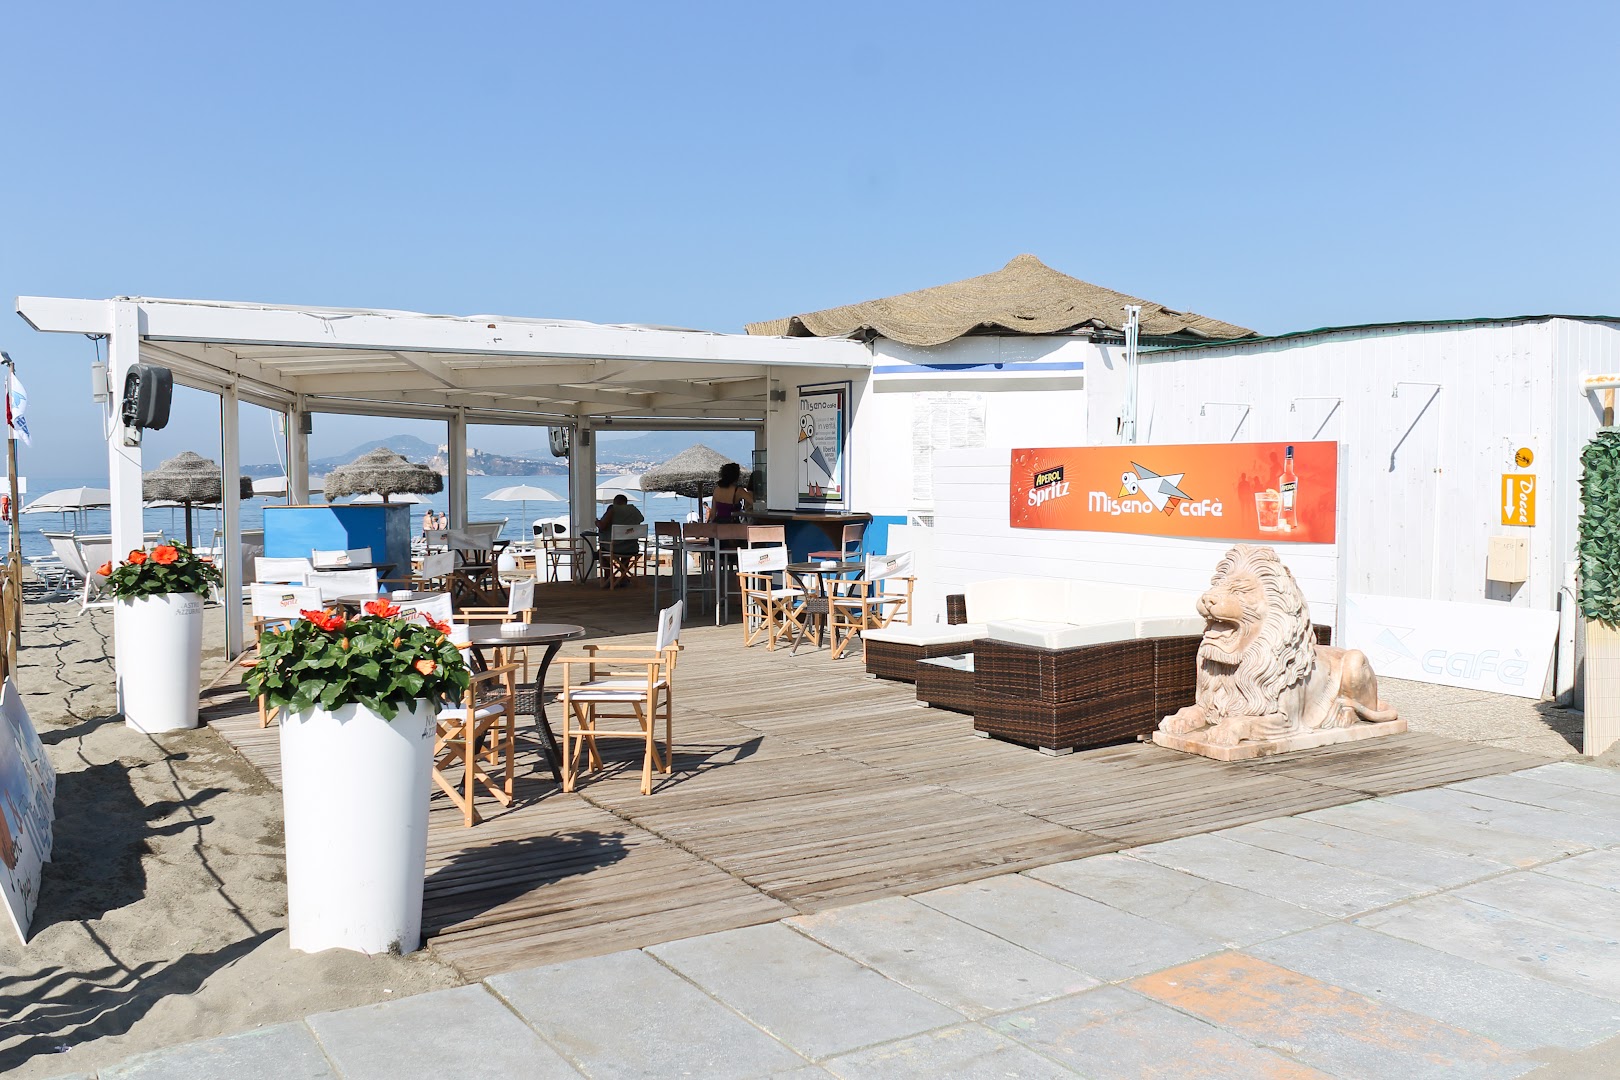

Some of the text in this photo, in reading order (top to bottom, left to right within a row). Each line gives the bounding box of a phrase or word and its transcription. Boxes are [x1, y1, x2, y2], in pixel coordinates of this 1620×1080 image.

[800, 399, 827, 411] Miseno
[1036, 471, 1061, 486] APEROL
[1027, 481, 1070, 507] Spritz
[1088, 491, 1223, 517] Miseno cafè
[1519, 477, 1534, 523] Docce
[1421, 649, 1529, 687] cafè
